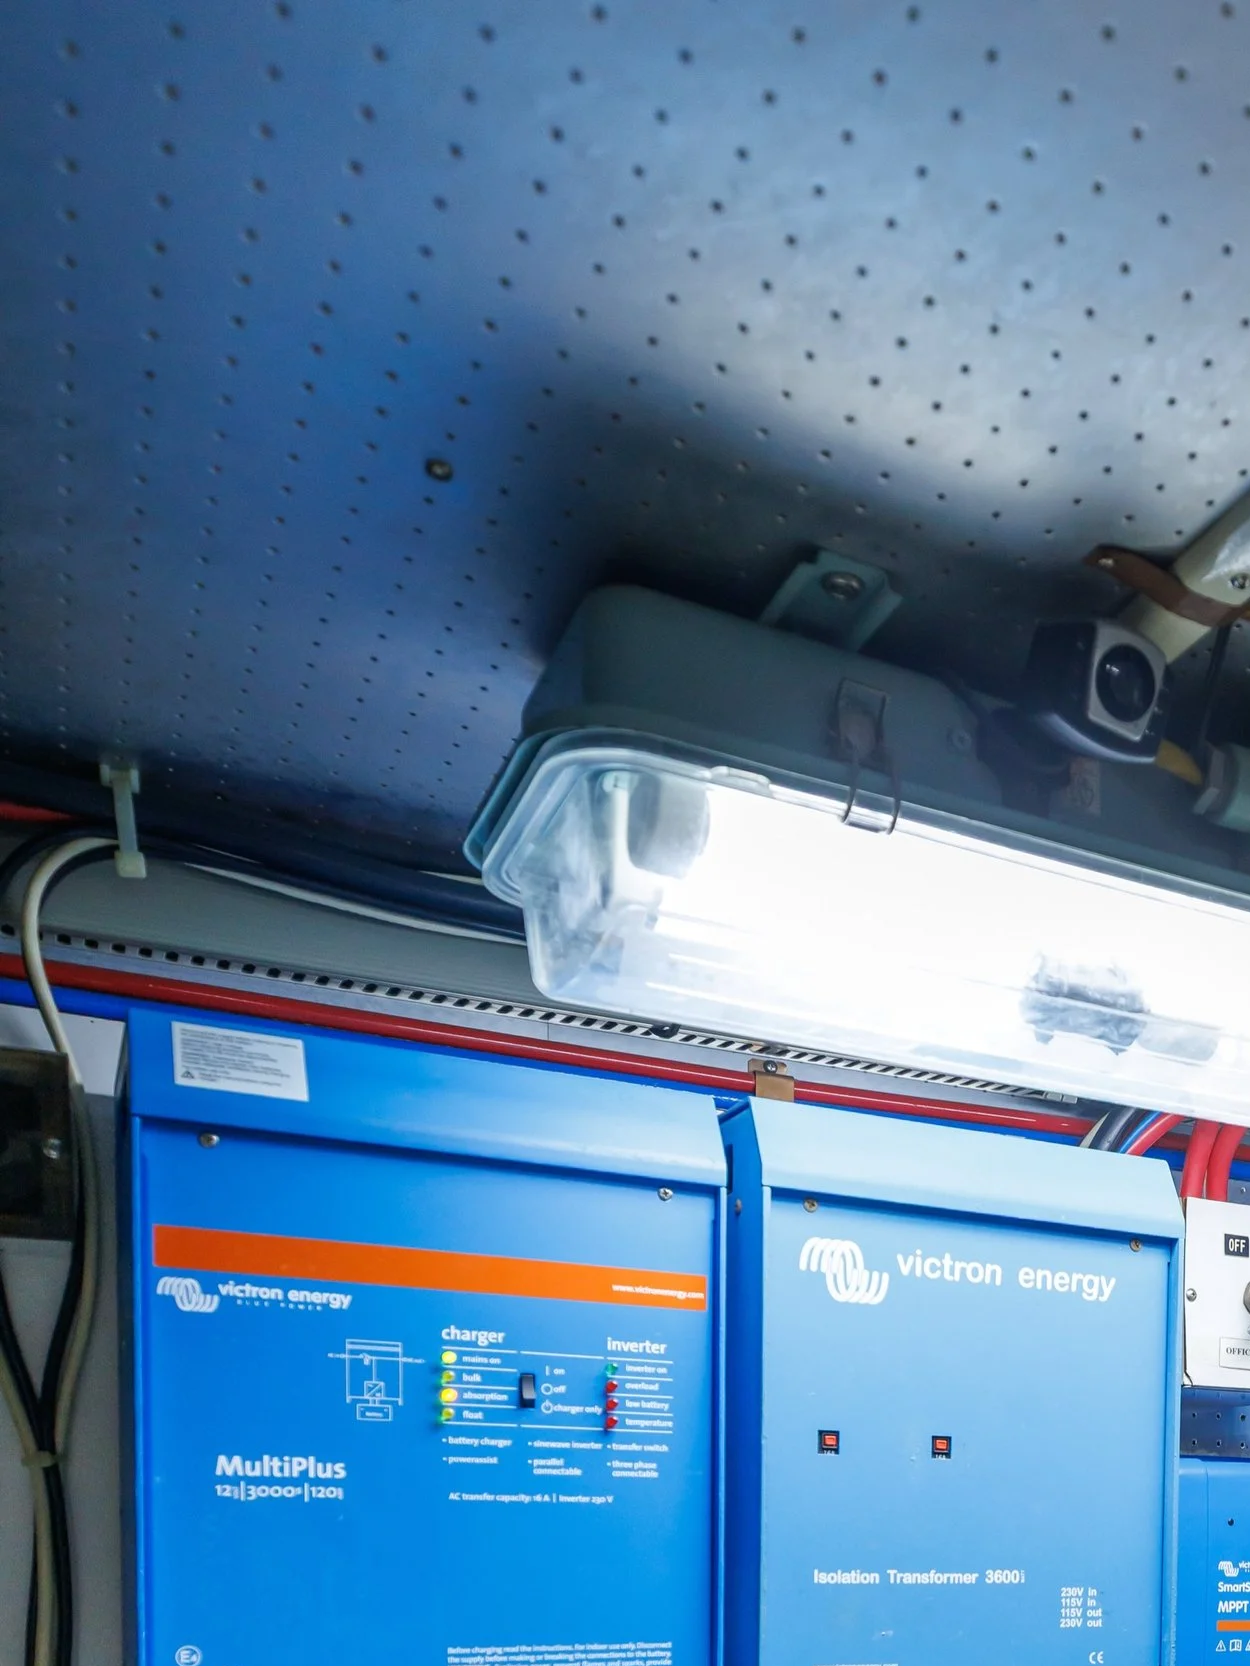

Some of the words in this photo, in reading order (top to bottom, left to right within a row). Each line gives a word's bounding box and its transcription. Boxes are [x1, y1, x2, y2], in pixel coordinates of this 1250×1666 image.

[1228, 1238, 1246, 1253] OFF
[896, 1249, 1002, 1286] victron
[1018, 1266, 1116, 1302] energy
[218, 1280, 284, 1300] victron
[287, 1289, 352, 1310] energy
[441, 1325, 506, 1347] charger
[607, 1337, 667, 1355] inverter
[462, 1354, 487, 1363] mains
[488, 1357, 501, 1365] on
[626, 1364, 655, 1373] inverter
[462, 1373, 481, 1382] bulk
[554, 1385, 566, 1393] off
[625, 1382, 659, 1391] overload
[462, 1390, 508, 1402] absorption
[554, 1405, 584, 1414] charger
[585, 1405, 602, 1415] only
[625, 1399, 640, 1408] low
[641, 1401, 669, 1412] battery
[462, 1410, 483, 1420] float
[625, 1418, 673, 1428] temperature
[448, 1436, 479, 1447] battery
[480, 1438, 512, 1448] charger
[572, 1441, 602, 1450] inverter
[612, 1443, 642, 1452] transfer
[643, 1444, 668, 1452] switch
[215, 1454, 347, 1479] MultiPlus
[612, 1460, 632, 1469] three
[633, 1461, 657, 1471] phase
[449, 1492, 461, 1500] AC
[814, 1569, 880, 1584] Isolation
[887, 1569, 978, 1584] Transformer
[985, 1569, 1019, 1584] 3600
[1060, 1587, 1084, 1597] 230V
[1088, 1587, 1097, 1596] in
[1060, 1598, 1083, 1607] 115V
[1087, 1598, 1096, 1606] in
[1217, 1601, 1249, 1613] MPPT
[1060, 1608, 1083, 1617] 115V
[1086, 1608, 1102, 1617] out
[1060, 1618, 1083, 1628] 230V
[1086, 1618, 1103, 1628] out
